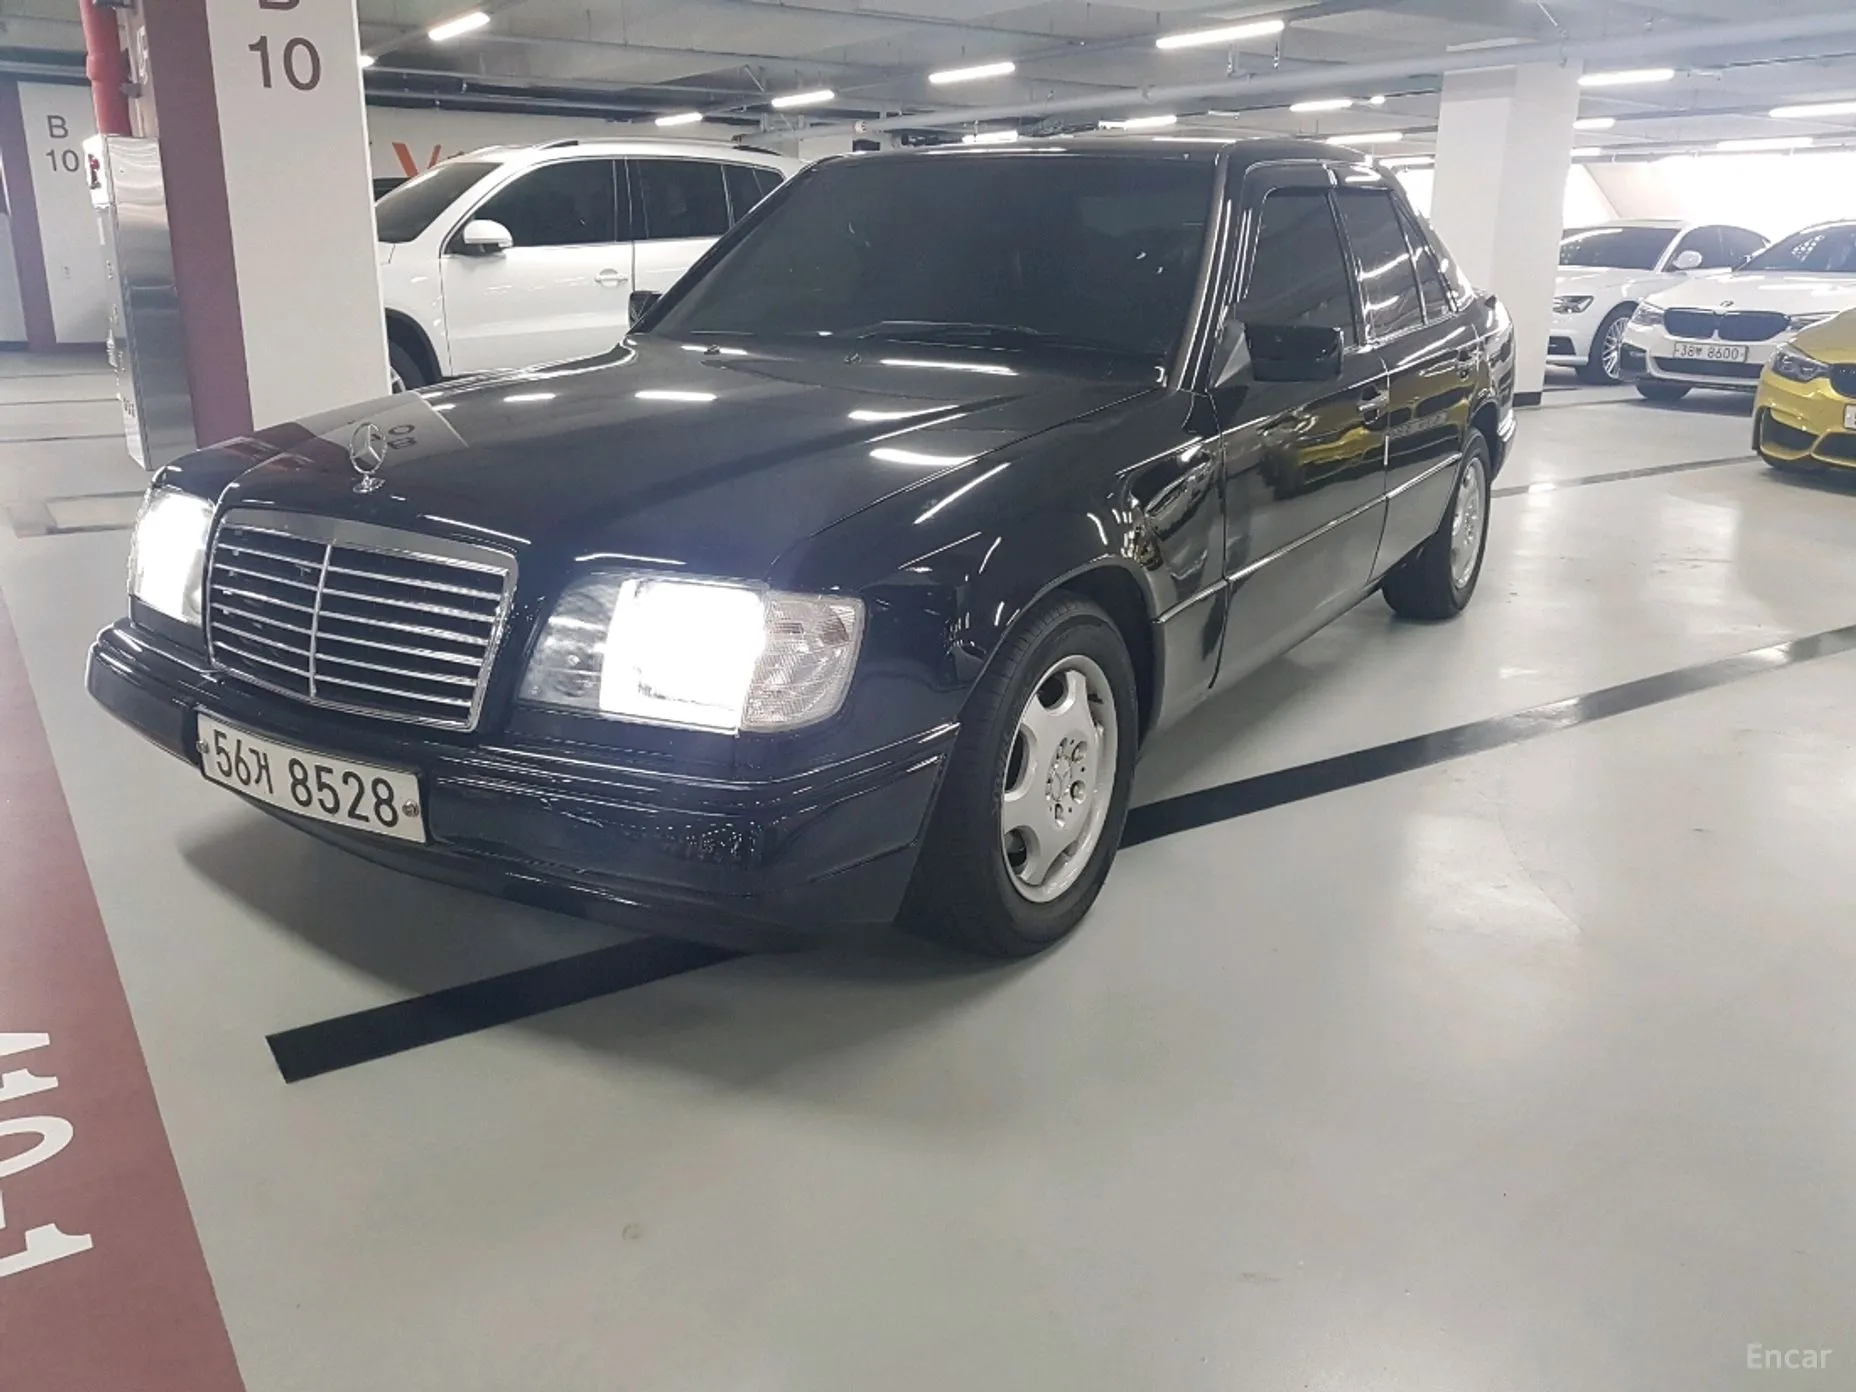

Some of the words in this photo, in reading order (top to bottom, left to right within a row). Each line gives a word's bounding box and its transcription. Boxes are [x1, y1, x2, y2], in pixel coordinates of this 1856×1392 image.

[248, 35, 321, 91] 10
[47, 115, 69, 139] B
[45, 150, 80, 172] 10
[1707, 347, 1739, 360] 8600
[213, 729, 273, 794] 56거
[289, 758, 399, 828] 8528
